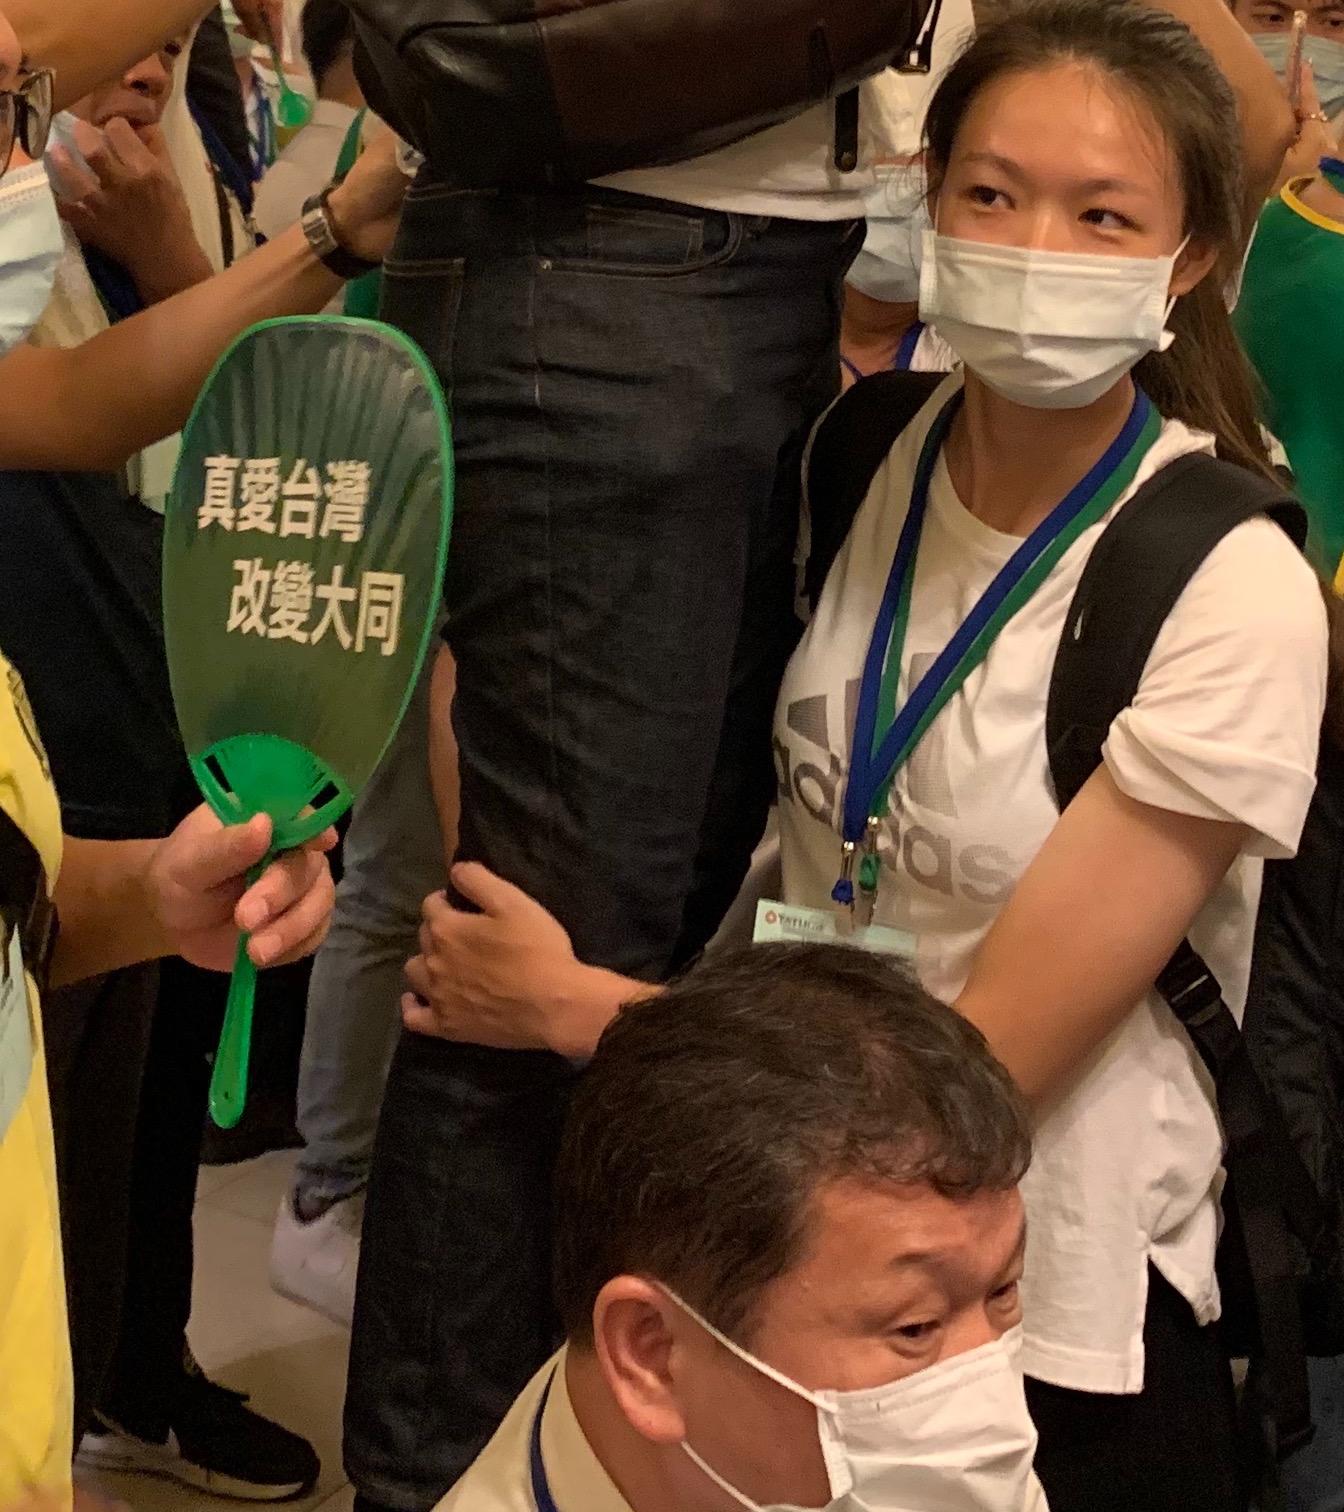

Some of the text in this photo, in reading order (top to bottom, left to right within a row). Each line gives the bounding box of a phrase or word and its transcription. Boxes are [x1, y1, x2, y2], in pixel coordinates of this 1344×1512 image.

[198, 455, 372, 543] 真愛台灣
[227, 557, 405, 657] 改變大同
